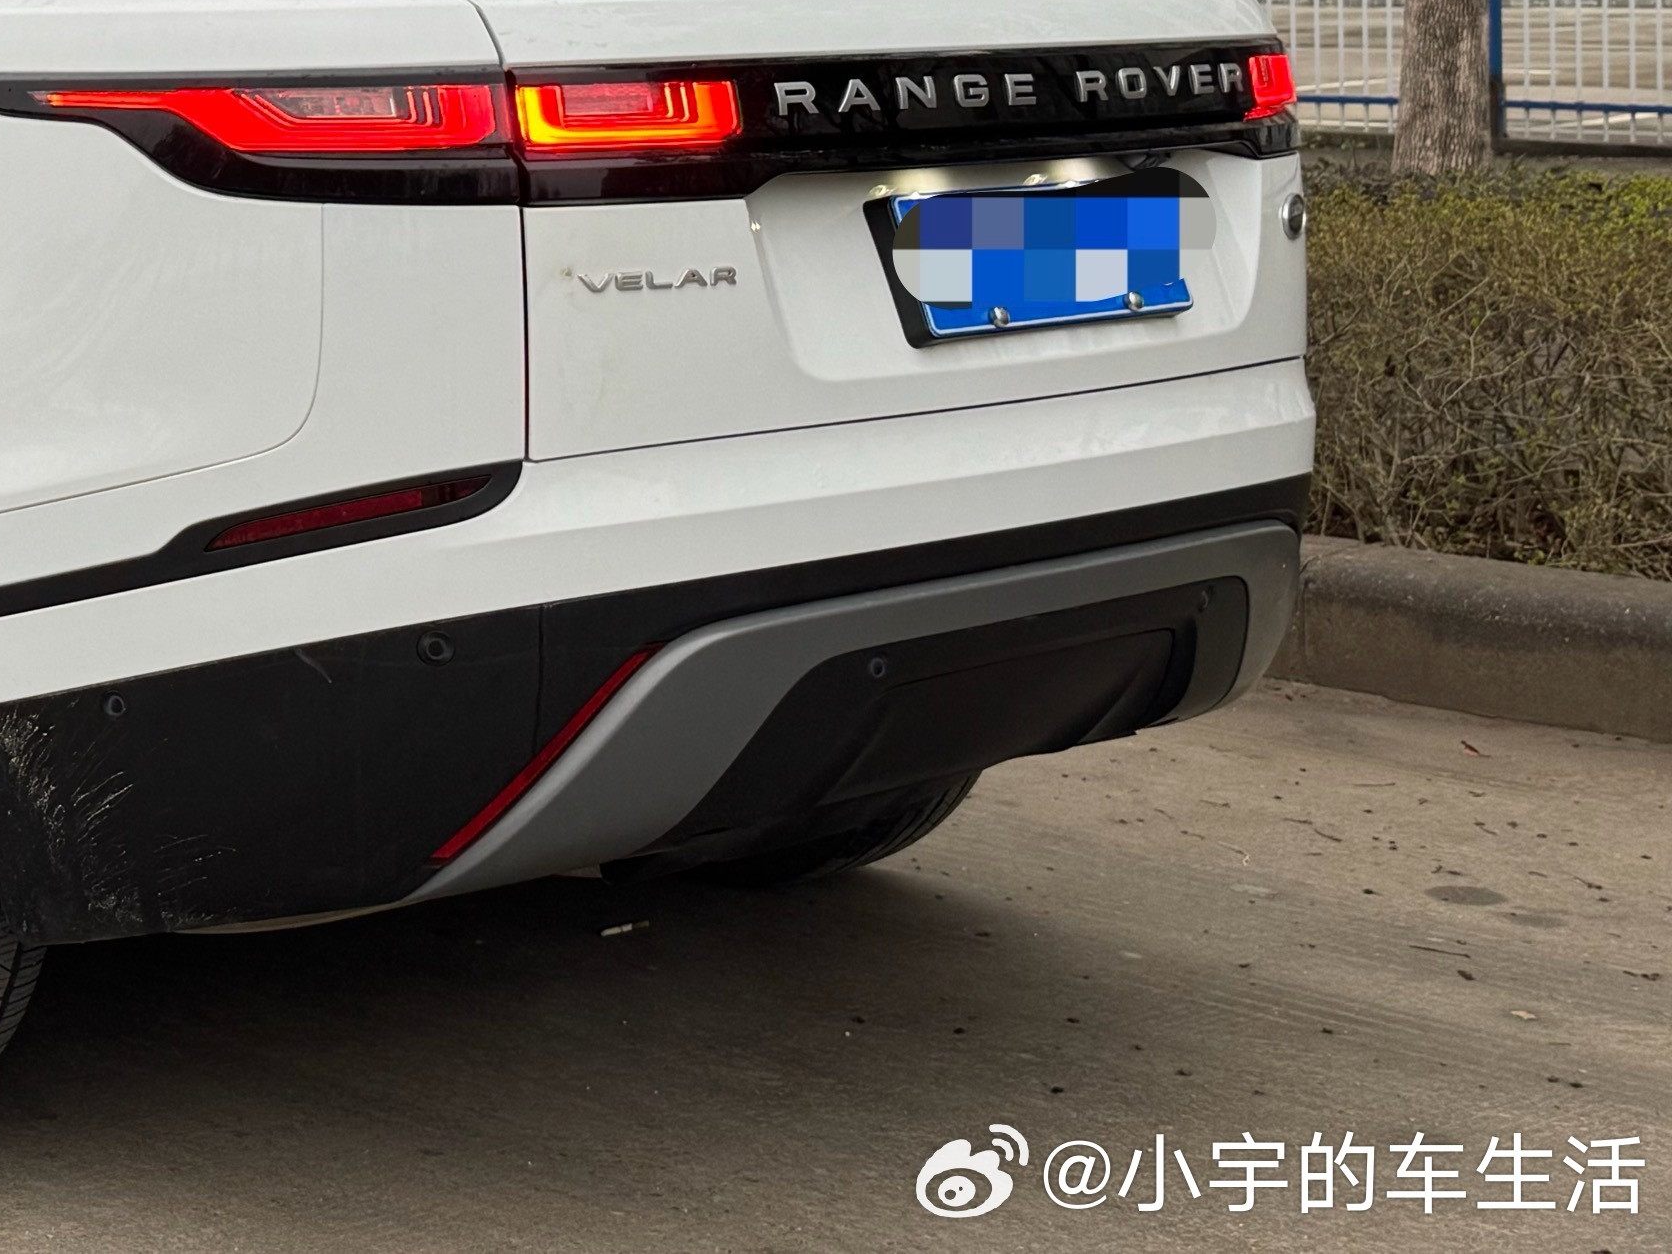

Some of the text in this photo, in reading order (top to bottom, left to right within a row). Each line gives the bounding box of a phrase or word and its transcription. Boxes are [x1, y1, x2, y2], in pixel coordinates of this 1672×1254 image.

[774, 62, 1245, 116] RANGE ROVER
[577, 266, 737, 293] VELAR
